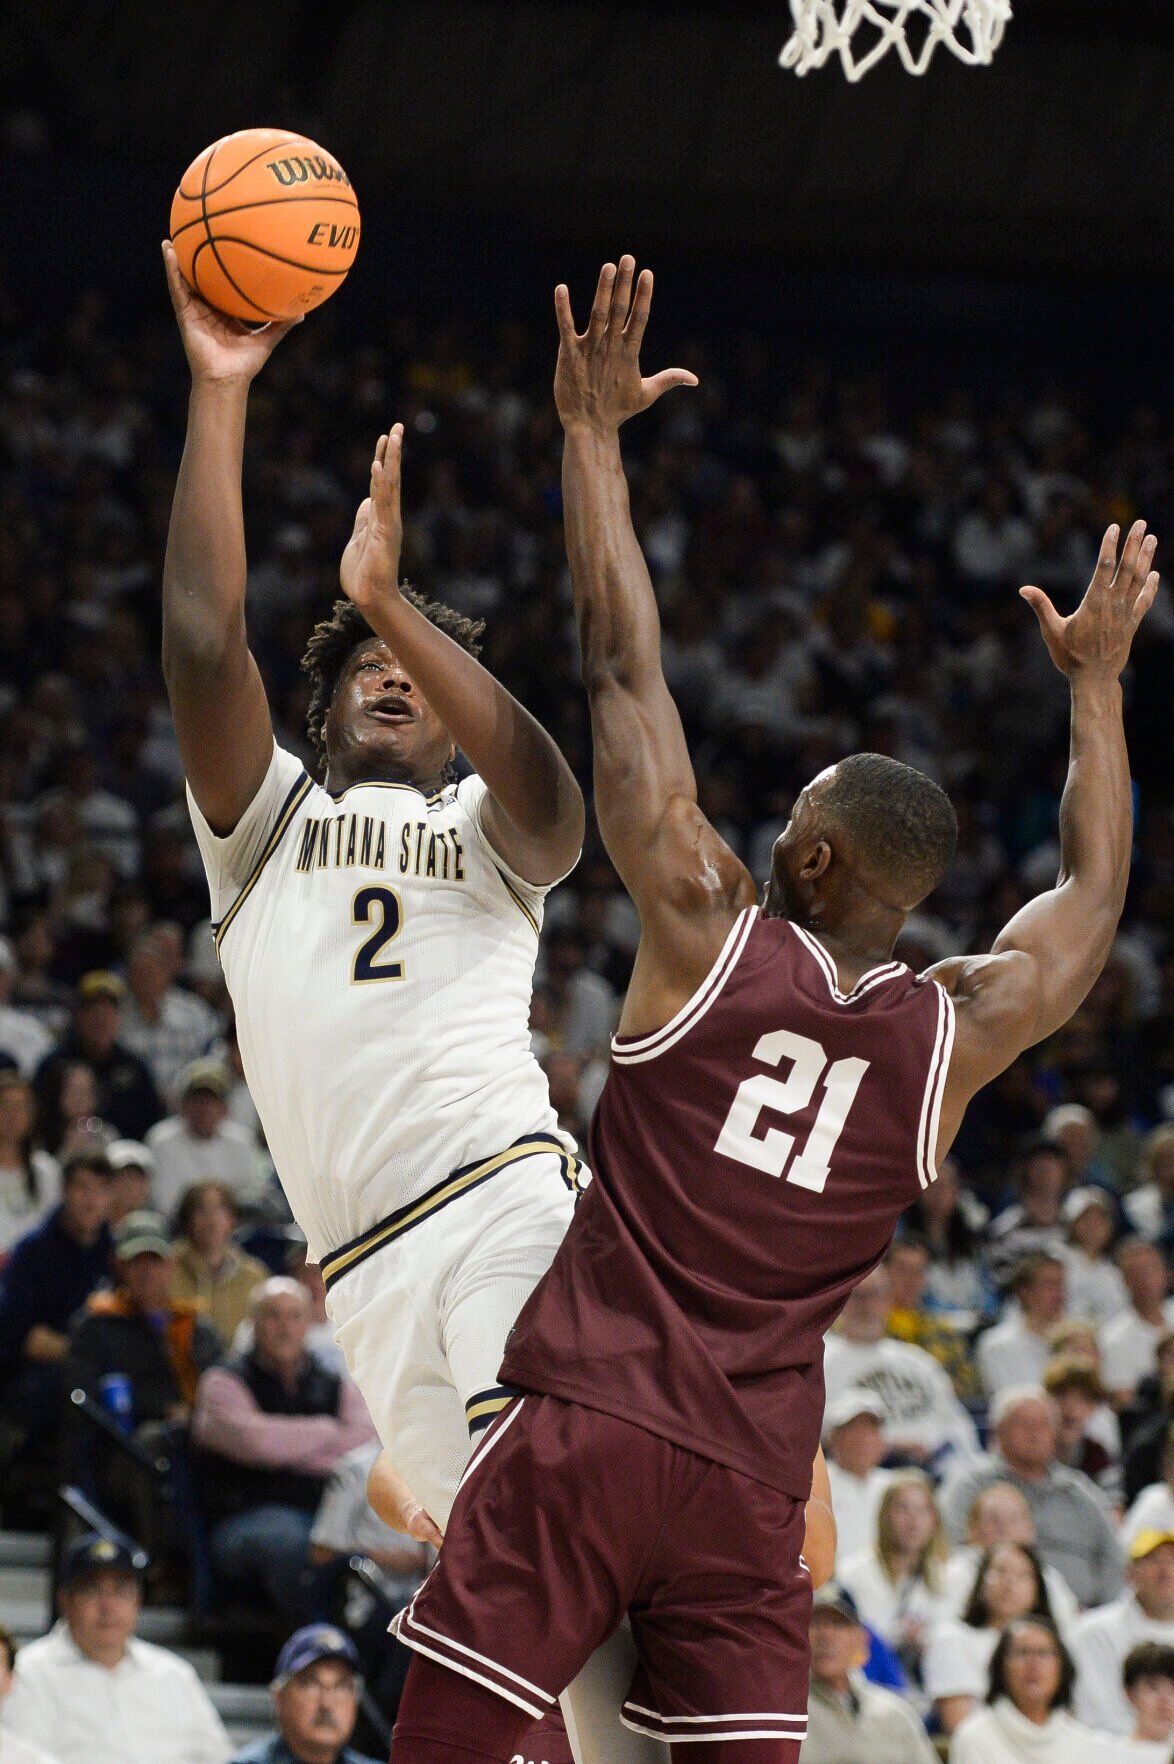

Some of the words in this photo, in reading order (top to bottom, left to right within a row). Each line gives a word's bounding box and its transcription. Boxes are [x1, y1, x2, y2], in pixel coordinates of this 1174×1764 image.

[266, 156, 351, 186] Wils
[294, 812, 386, 874] MNTANA
[399, 819, 466, 881] STATE
[350, 882, 406, 986] 2
[713, 1029, 871, 1194] 21
